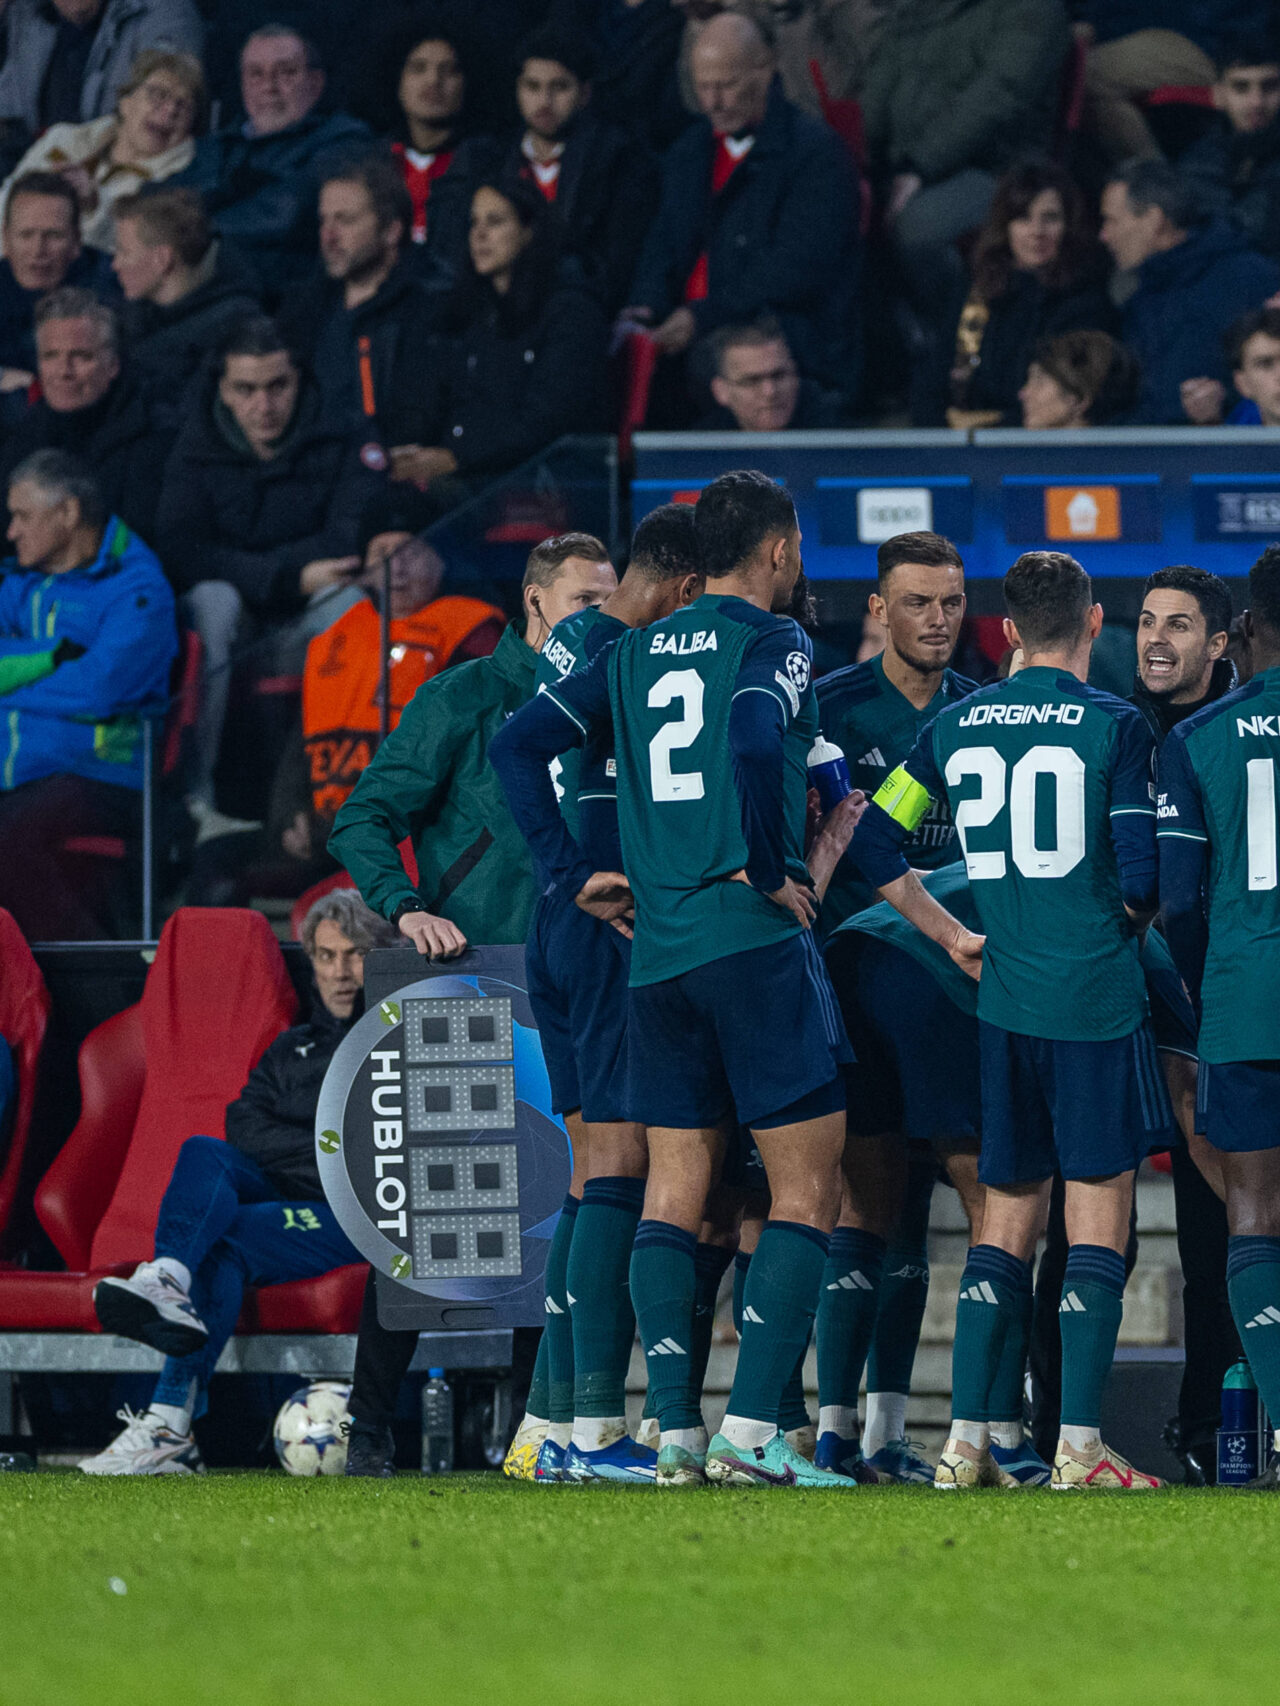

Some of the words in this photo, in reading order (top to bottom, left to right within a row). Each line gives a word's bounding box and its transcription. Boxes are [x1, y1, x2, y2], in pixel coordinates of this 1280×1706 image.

[541, 631, 577, 676] ABRIEL
[649, 629, 718, 655] SALIBA
[958, 703, 1085, 728] JORGINHO
[647, 668, 705, 802] 2
[944, 744, 1087, 880] 20
[1156, 804, 1180, 820] NDA
[904, 823, 957, 847] ETTER
[370, 1050, 408, 1239] HUBLOT
